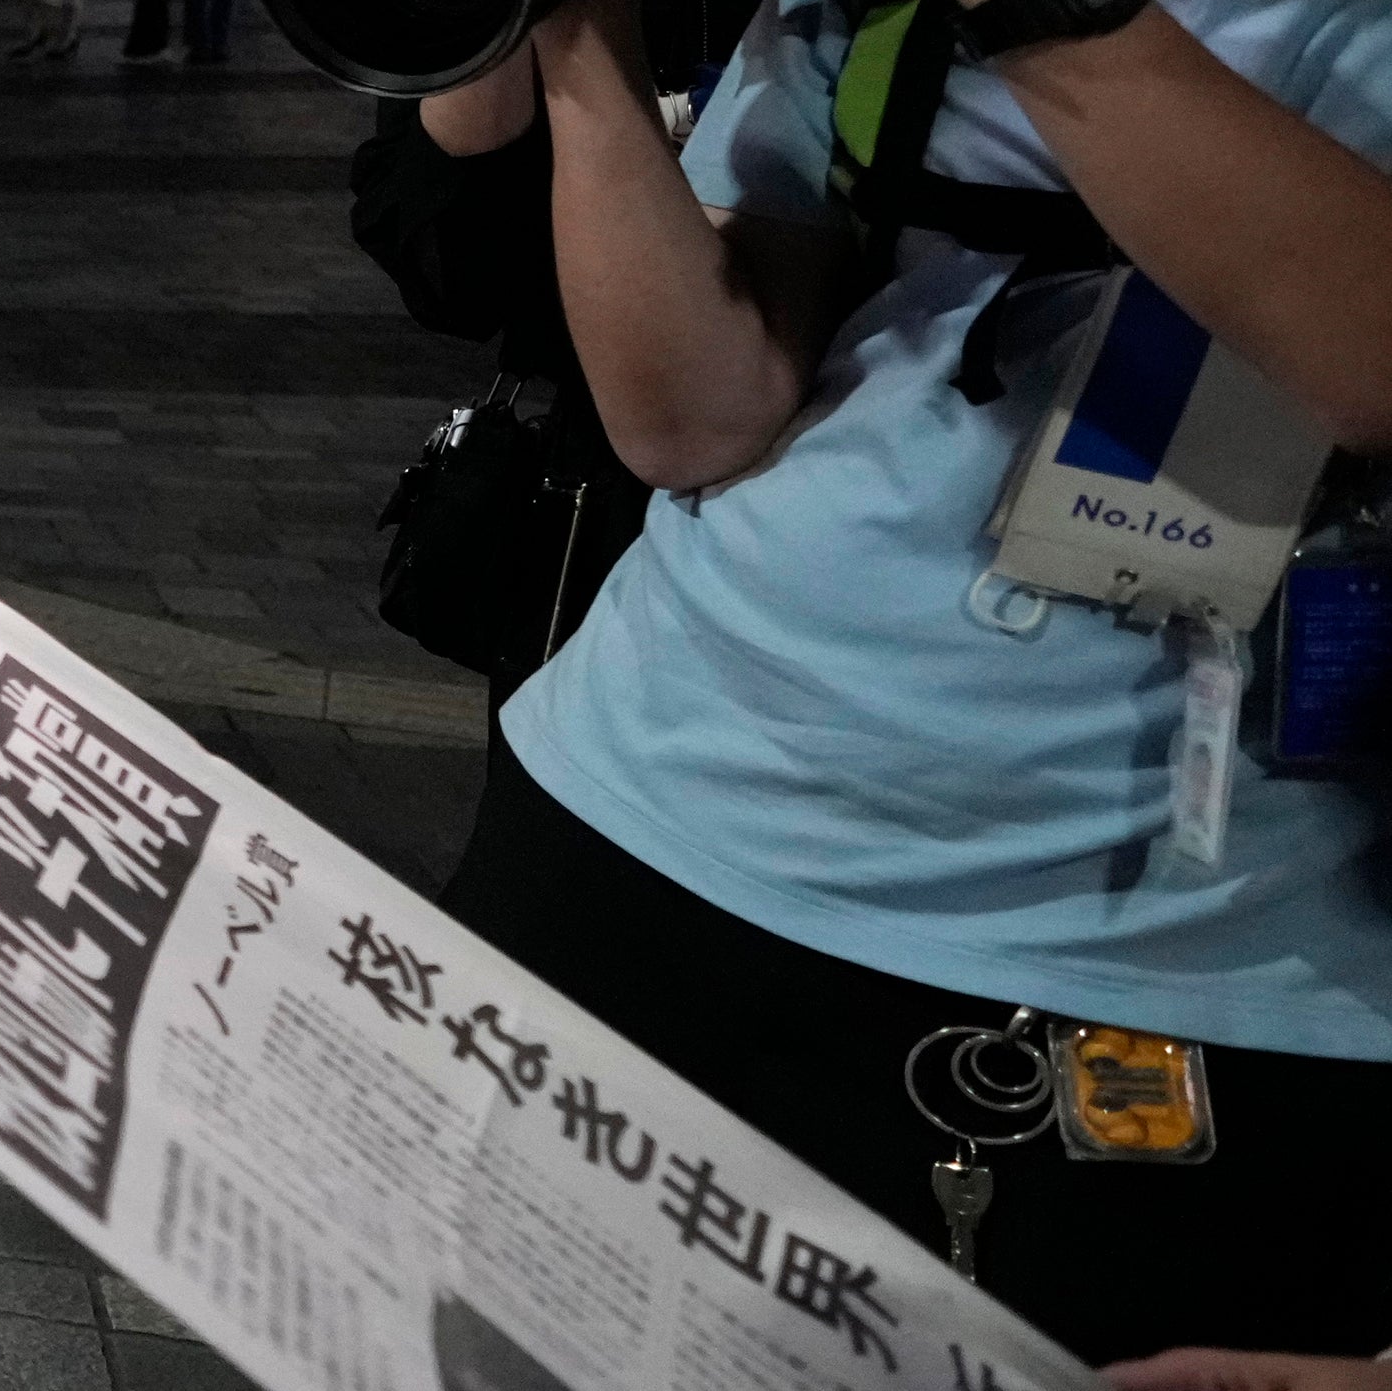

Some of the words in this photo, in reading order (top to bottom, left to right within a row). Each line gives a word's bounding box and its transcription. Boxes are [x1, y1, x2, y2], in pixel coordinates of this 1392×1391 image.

[1071, 494, 1213, 549] No.166
[193, 833, 300, 1036] ノーベル賞
[326, 911, 1009, 1391] 核なき世界
